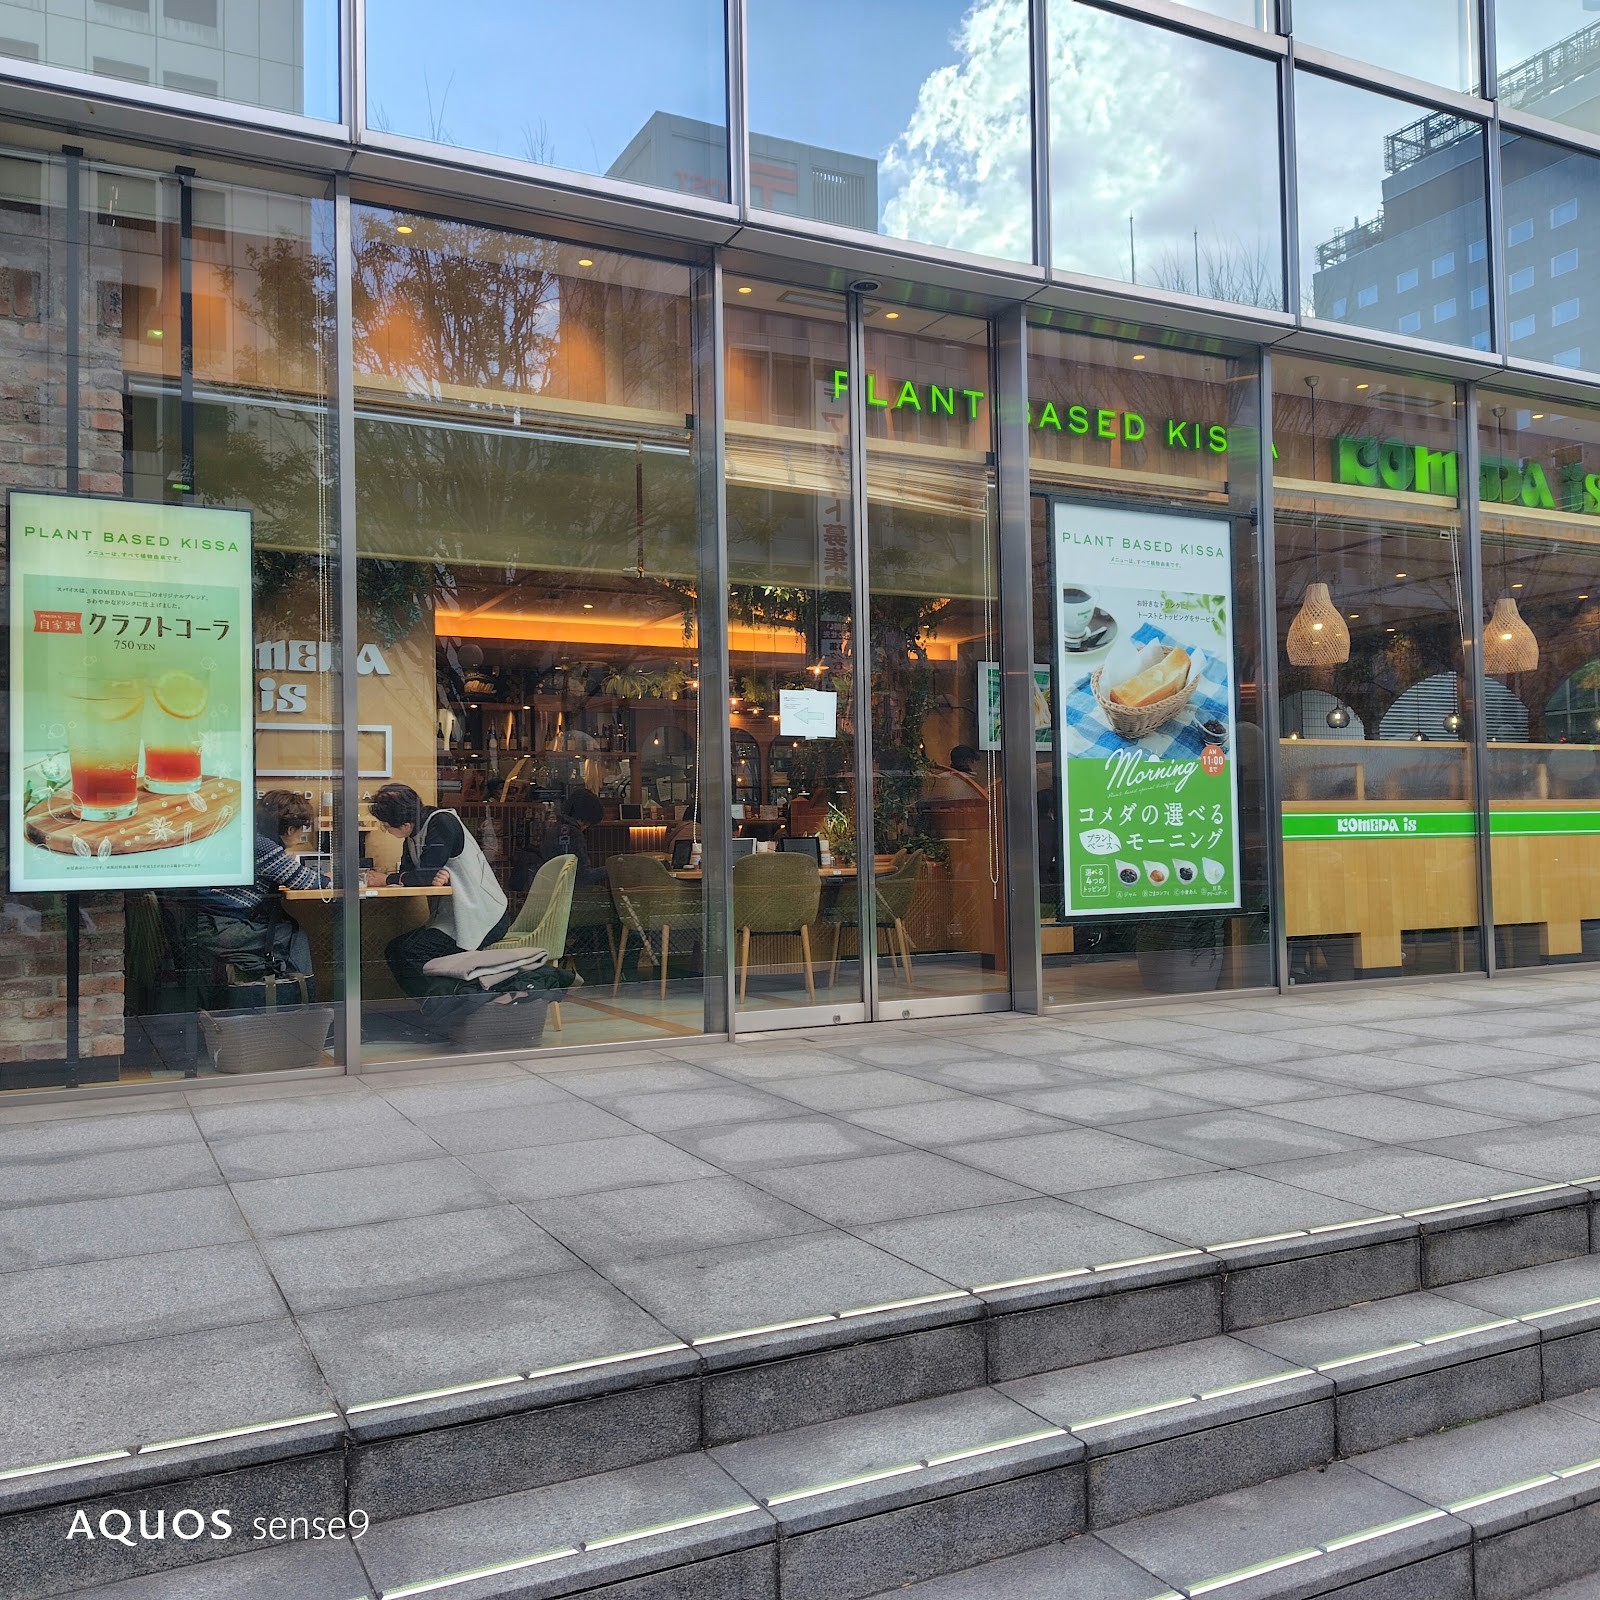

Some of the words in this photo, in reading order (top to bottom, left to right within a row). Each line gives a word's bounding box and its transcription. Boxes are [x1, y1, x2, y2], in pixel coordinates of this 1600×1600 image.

[833, 370, 984, 419] PLANT
[1334, 433, 1557, 510] KOMDA
[24, 526, 93, 542] PLANT
[103, 531, 170, 548] BASED
[180, 537, 239, 553] KISSA
[1062, 532, 1114, 549] PLANT
[1122, 537, 1173, 553] BASED
[1180, 543, 1225, 559] KISSA
[92, 588, 127, 597] KOMEDA
[39, 619, 77, 631] 自家製
[89, 612, 231, 641] クラフトコーラ
[113, 639, 135, 650] 750
[137, 643, 156, 651] YEN
[259, 677, 307, 713] is
[1104, 748, 1199, 793] Morning
[1202, 755, 1224, 766] 11:00
[1079, 802, 1224, 828] コメダの選べる
[1337, 817, 1399, 833] KOMEDA
[1403, 816, 1417, 832] is
[1126, 828, 1224, 851] モーニング
[1085, 868, 1104, 877] 選べる
[1085, 877, 1105, 885] 4つの
[1083, 885, 1108, 893] トッピング
